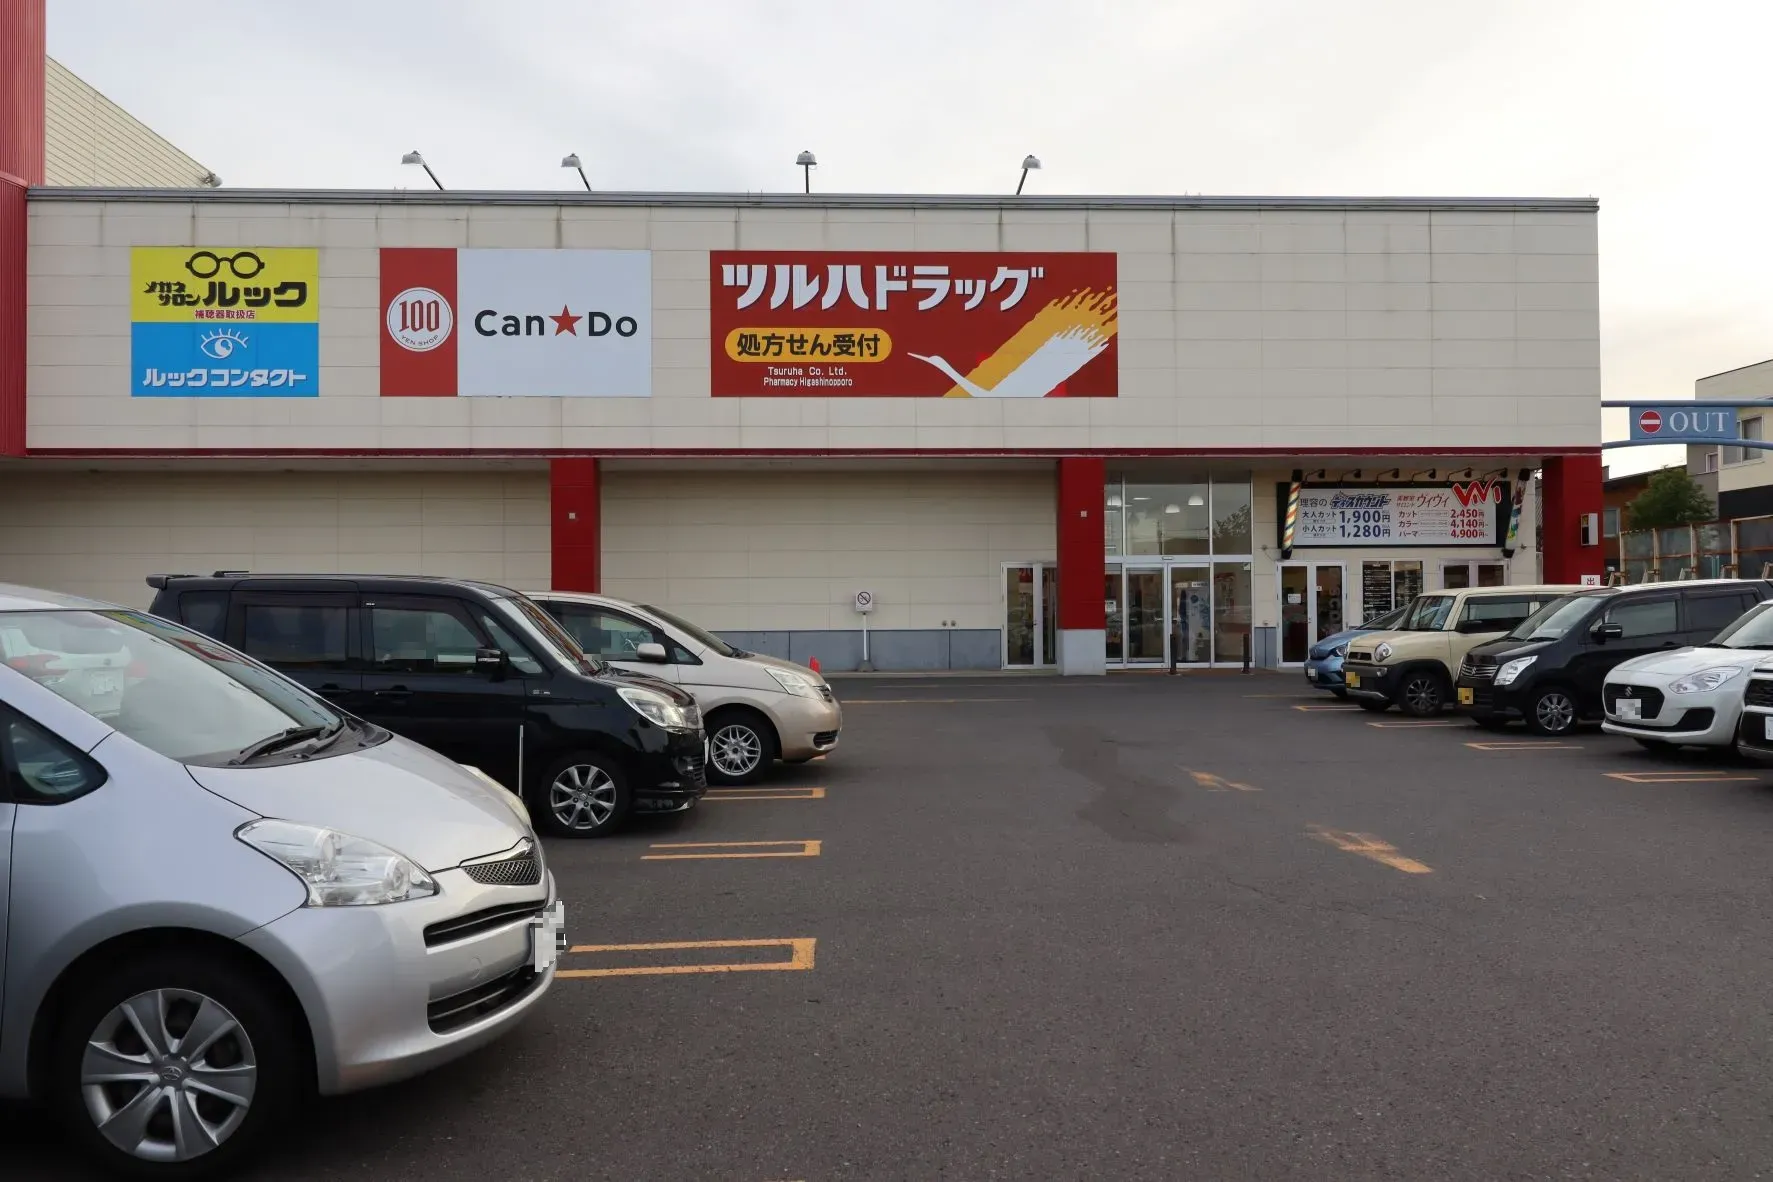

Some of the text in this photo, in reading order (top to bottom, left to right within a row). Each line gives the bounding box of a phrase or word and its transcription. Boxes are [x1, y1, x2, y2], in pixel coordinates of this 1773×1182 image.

[144, 281, 186, 294] メガネ
[721, 263, 1044, 312] ツルハドラッグ
[158, 293, 201, 306] サロン
[203, 281, 308, 307] ルック
[194, 309, 256, 320] 補聴器取扱店
[398, 299, 440, 333] 100
[401, 334, 439, 347] YEN SHOP
[736, 333, 881, 358] 処方せん受付
[768, 366, 848, 376] Tsuruha Co. Ltd.
[142, 368, 307, 388] ルックコンタクト
[763, 377, 853, 388] Pharmacy Higashinopporo
[1669, 411, 1729, 433] OUT
[1300, 497, 1327, 507] 理容の
[1416, 492, 1450, 507] ヴィヴィ
[1302, 510, 1336, 519] 大人カット
[1398, 510, 1418, 518] カット
[1302, 525, 1336, 533] 小人カット
[1398, 520, 1419, 528] カラー
[1398, 530, 1419, 538] パーマ
[1586, 577, 1595, 586] 出
